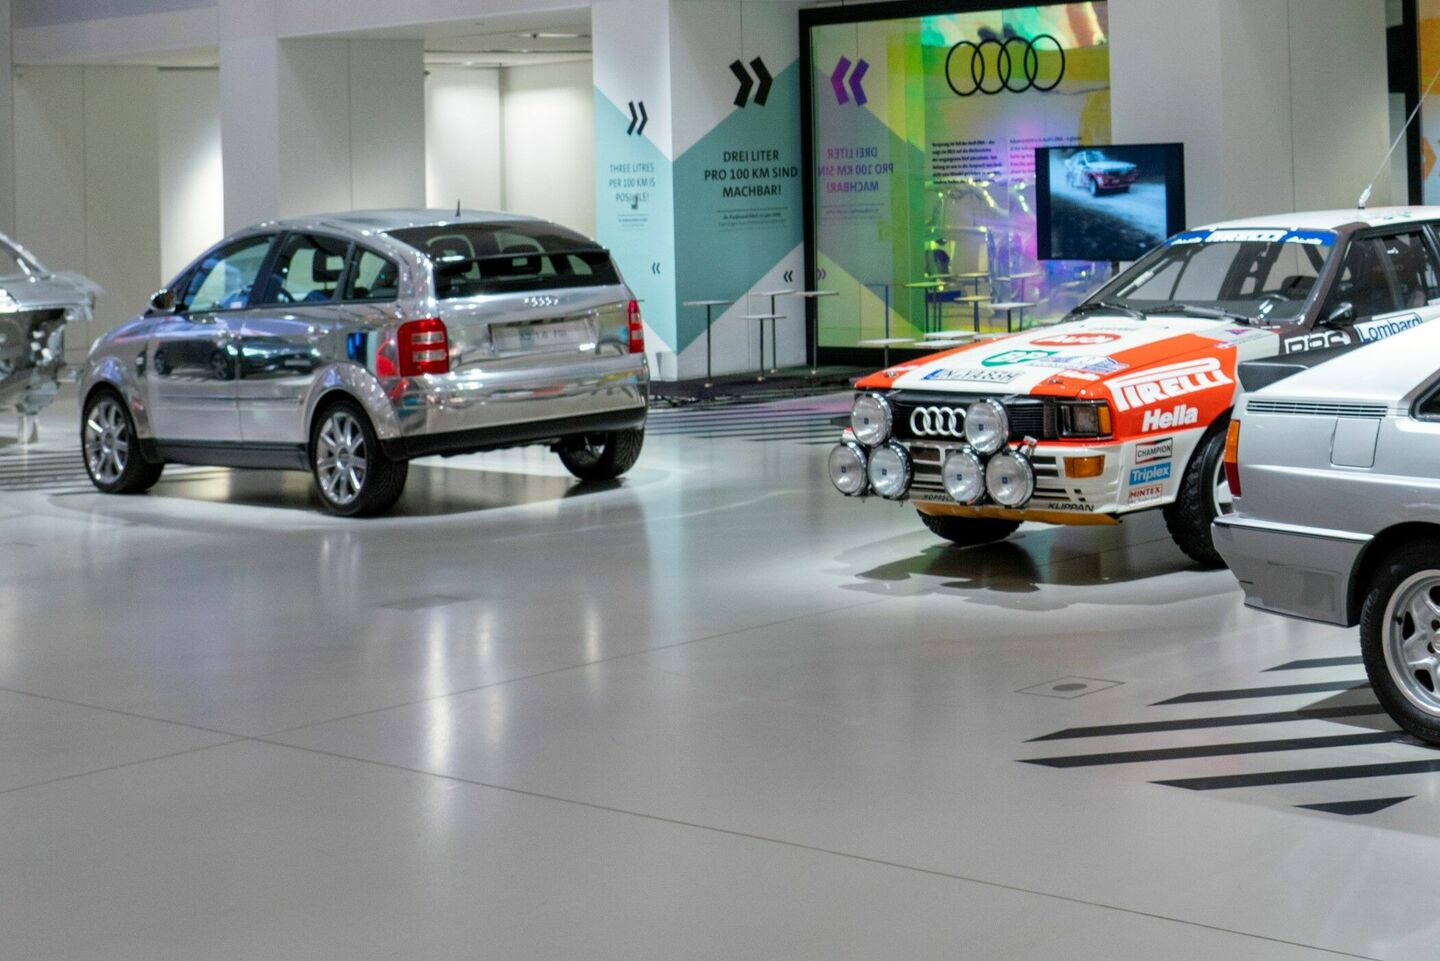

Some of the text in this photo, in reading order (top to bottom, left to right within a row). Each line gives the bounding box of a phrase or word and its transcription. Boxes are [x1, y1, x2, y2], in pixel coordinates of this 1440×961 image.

[723, 150, 780, 162] DREI LITER
[609, 162, 655, 173] THREE LITRES
[704, 166, 798, 180] PRO 100 KM SIND
[608, 178, 622, 188] PER
[722, 184, 782, 198] MACHBAR!
[1102, 357, 1234, 412] PIRELLI
[1141, 404, 1199, 432] Hella
[1137, 445, 1172, 458] CHAMPION
[1131, 466, 1170, 481] Triplex
[1129, 486, 1161, 498] MINTEX
[1047, 503, 1095, 513] KLIPPAN
